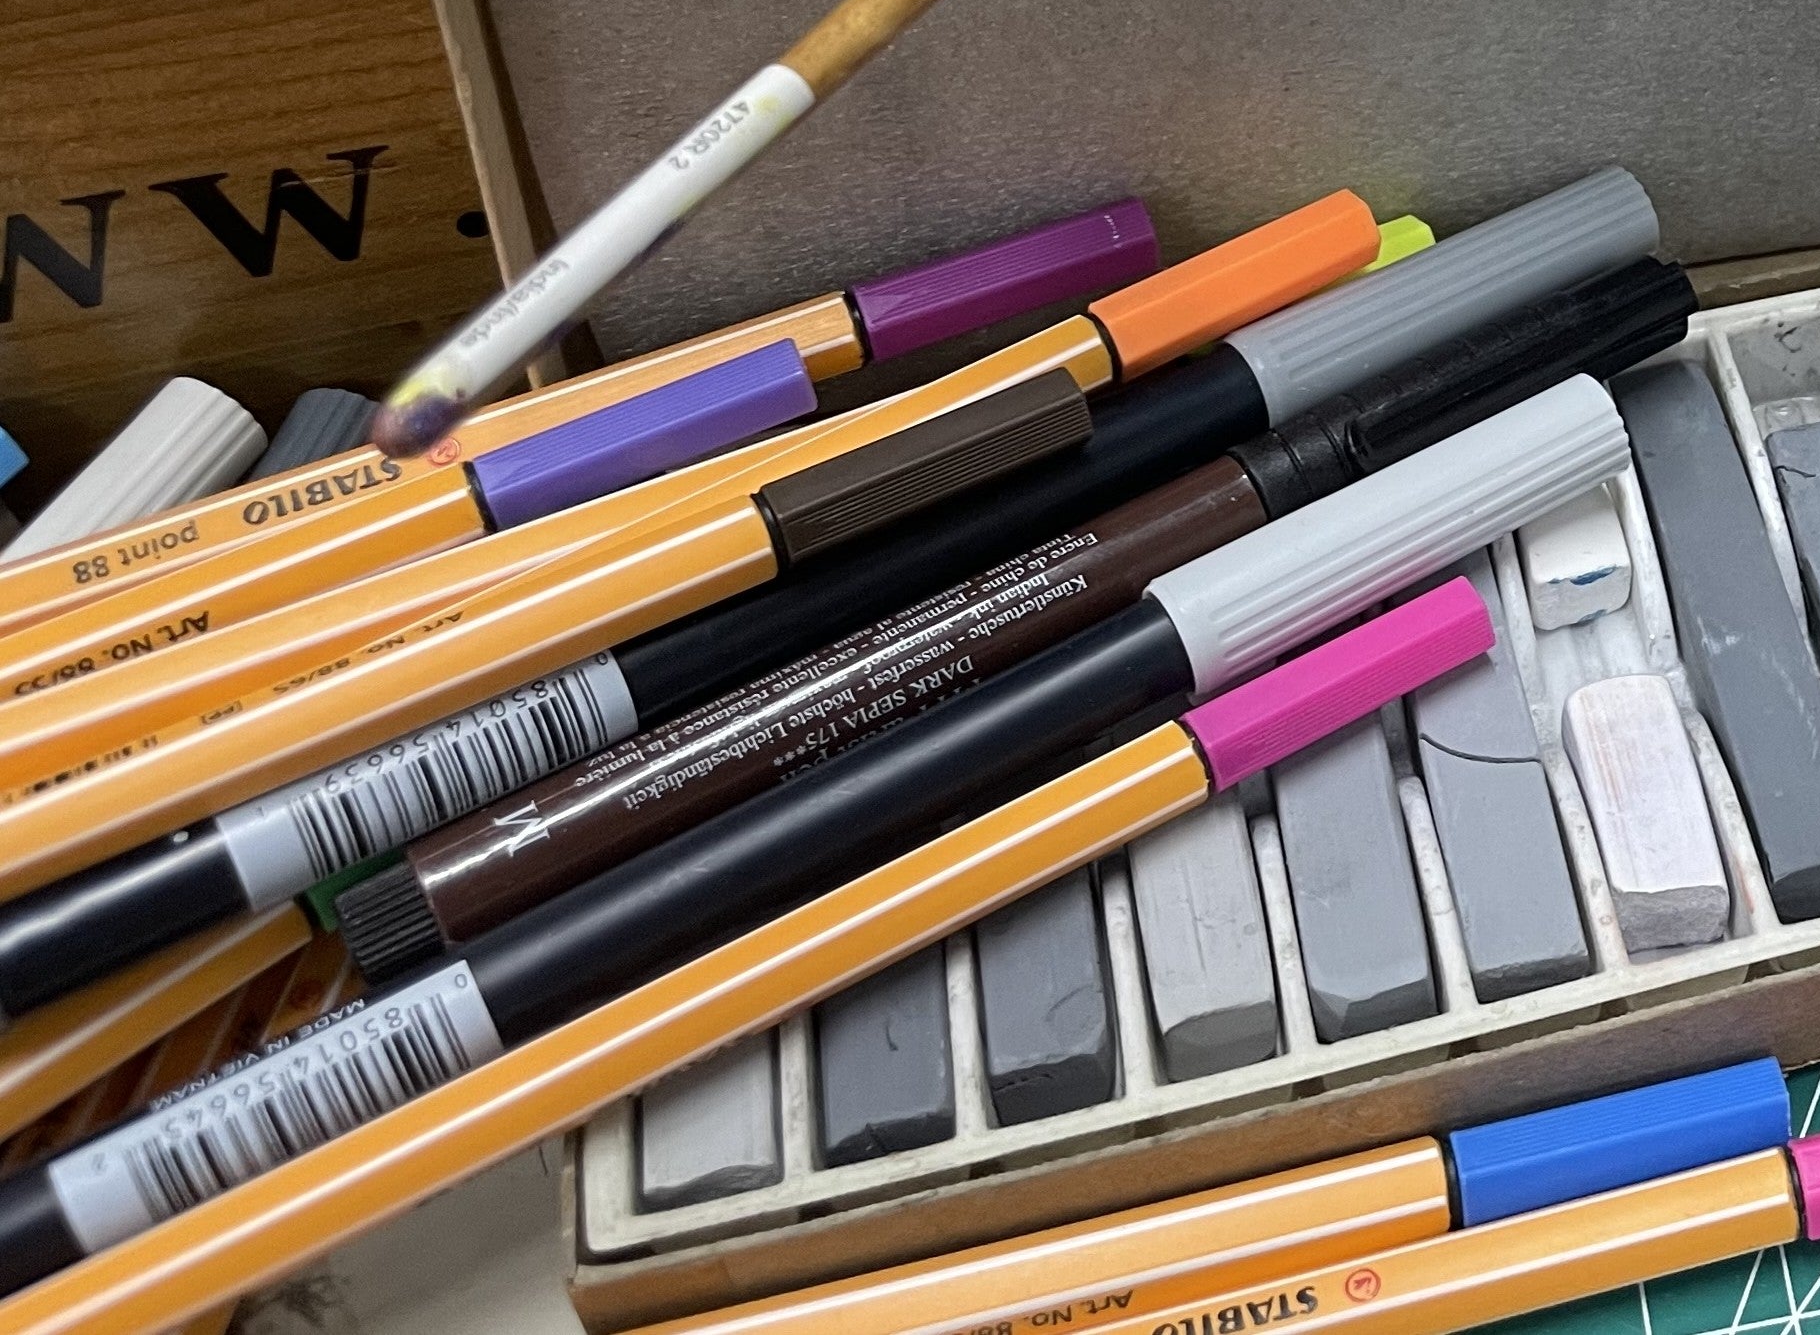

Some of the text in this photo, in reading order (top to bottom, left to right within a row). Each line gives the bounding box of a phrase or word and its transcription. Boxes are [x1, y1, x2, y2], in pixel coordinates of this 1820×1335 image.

[69, 455, 404, 585] STABILO point 88
[1048, 530, 1097, 563] Encre
[980, 564, 1026, 596] chine
[1026, 554, 1049, 573] de
[870, 590, 968, 649] permanente
[966, 572, 1088, 645] Künstlertusche
[967, 571, 1049, 622] Indian ink
[100, 611, 213, 665] Art. No.
[866, 636, 956, 693] wasserfest
[771, 643, 859, 697] excellente
[841, 653, 975, 732] DARK SEPIA
[443, 672, 551, 745] 85014
[786, 685, 857, 732] höchste
[321, 726, 430, 801] 56639
[573, 746, 645, 792] lumière
[619, 714, 789, 816] Lichtbeständigkeit
[646, 738, 665, 755] la
[148, 992, 366, 1116] MADE IN VIETNAM
[290, 1002, 406, 1081] 85014
[1022, 1305, 1072, 1330] No.
[1081, 1289, 1135, 1315] Art.
